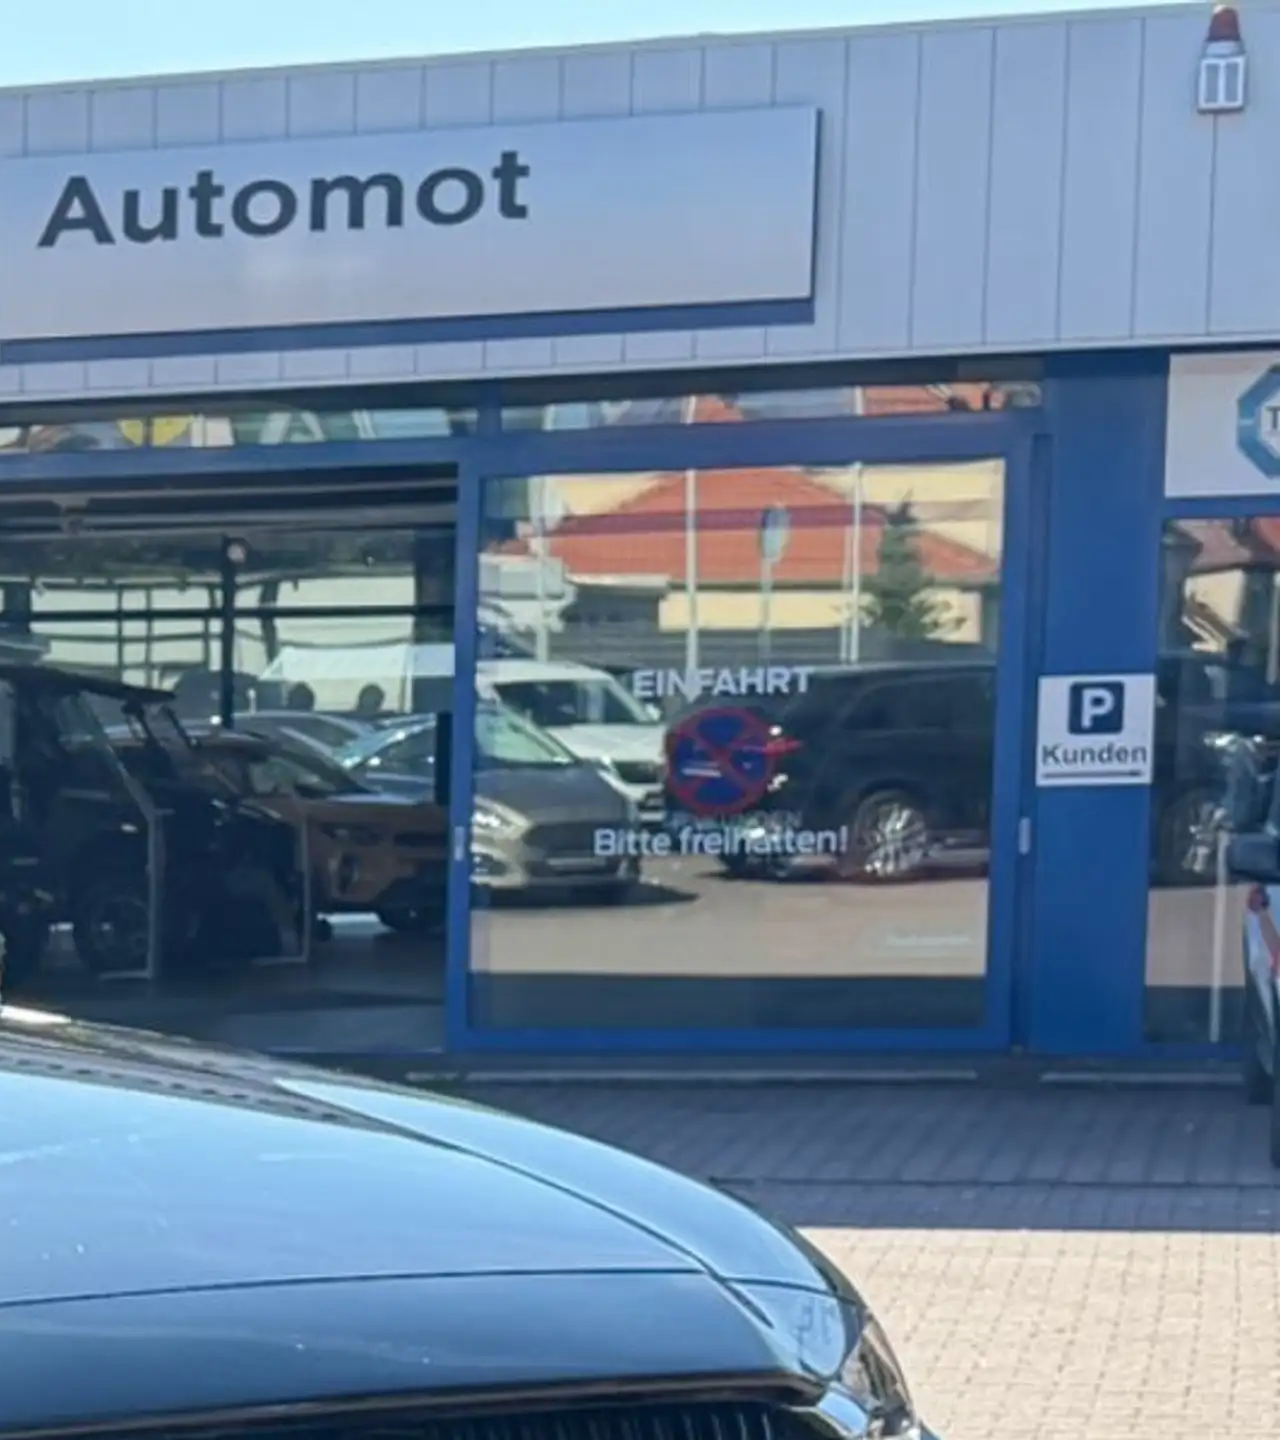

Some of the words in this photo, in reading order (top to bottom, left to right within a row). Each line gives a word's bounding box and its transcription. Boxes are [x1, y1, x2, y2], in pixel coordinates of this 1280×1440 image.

[37, 150, 531, 248] Automot
[631, 666, 816, 698] EINFAHRT
[1042, 742, 1147, 766] Kunden
[593, 828, 672, 856] Bitte
